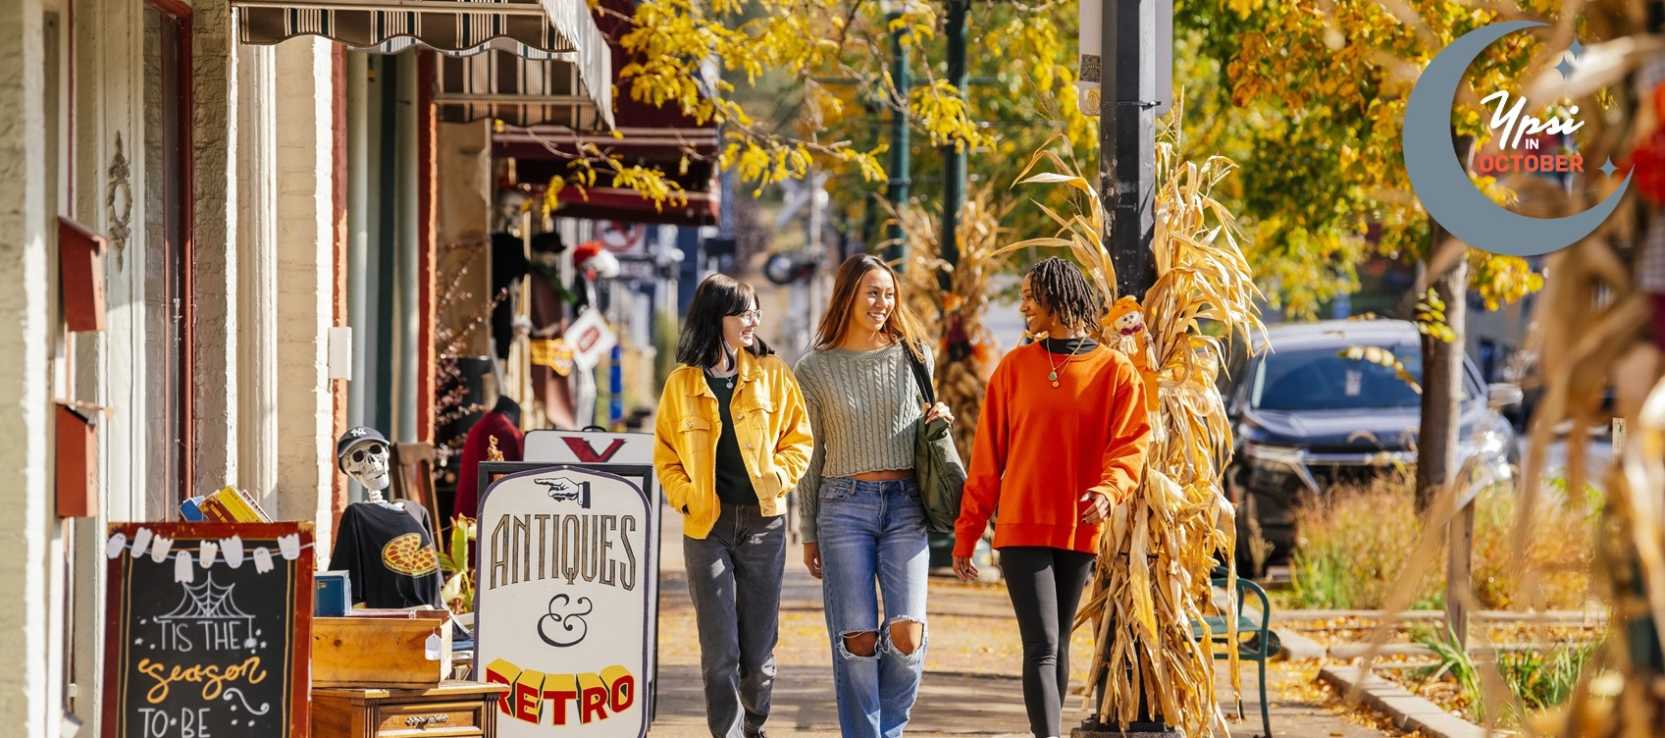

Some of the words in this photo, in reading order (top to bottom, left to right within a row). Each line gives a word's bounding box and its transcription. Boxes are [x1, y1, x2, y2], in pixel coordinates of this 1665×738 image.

[489, 513, 637, 592] ANTIQUES
[196, 620, 241, 651] THE
[537, 593, 593, 648] &
[138, 656, 267, 704] season
[486, 658, 635, 726] RETRO
